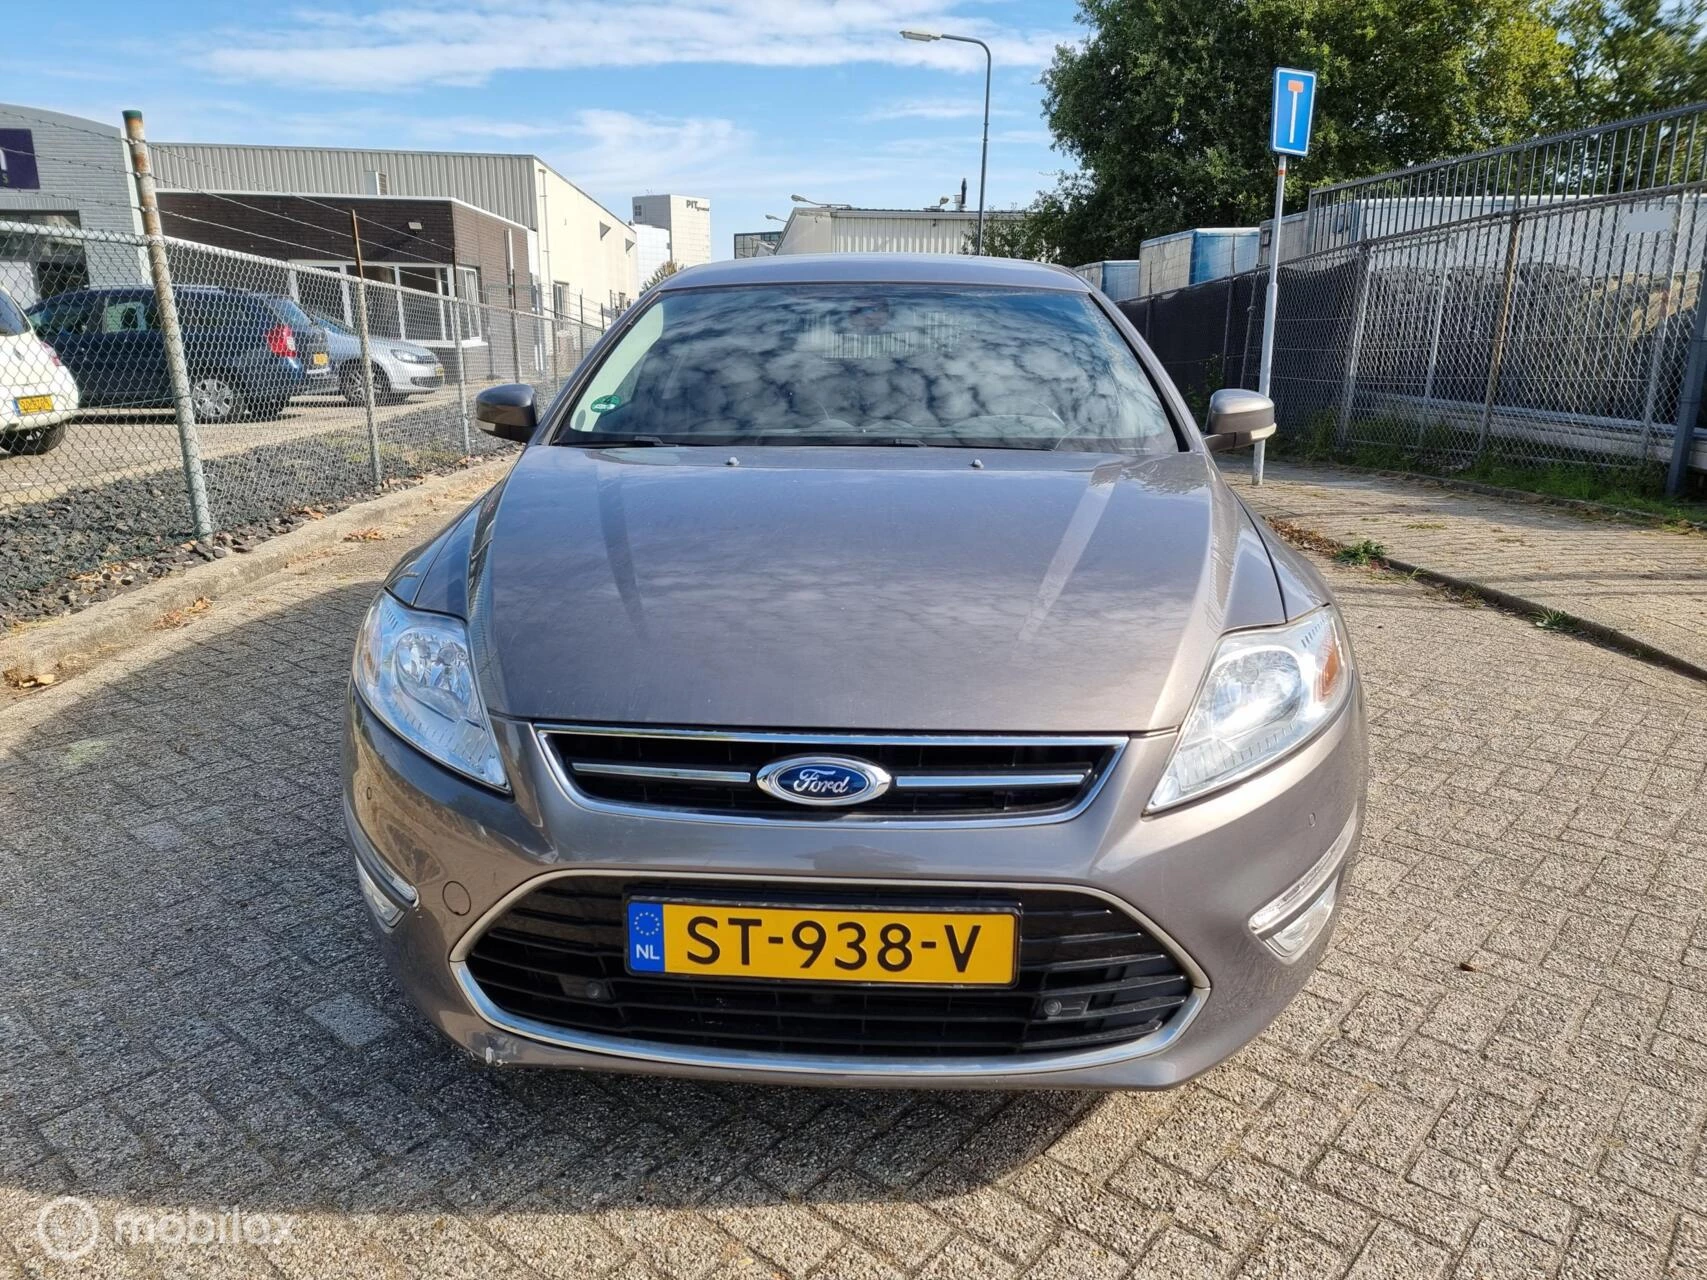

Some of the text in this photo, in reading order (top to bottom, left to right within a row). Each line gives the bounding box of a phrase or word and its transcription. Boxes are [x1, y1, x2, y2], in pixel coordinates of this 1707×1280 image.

[686, 199, 698, 209] PIT
[793, 768, 850, 793] Ford
[636, 943, 660, 961] NL
[686, 915, 982, 973] ST-938-V
